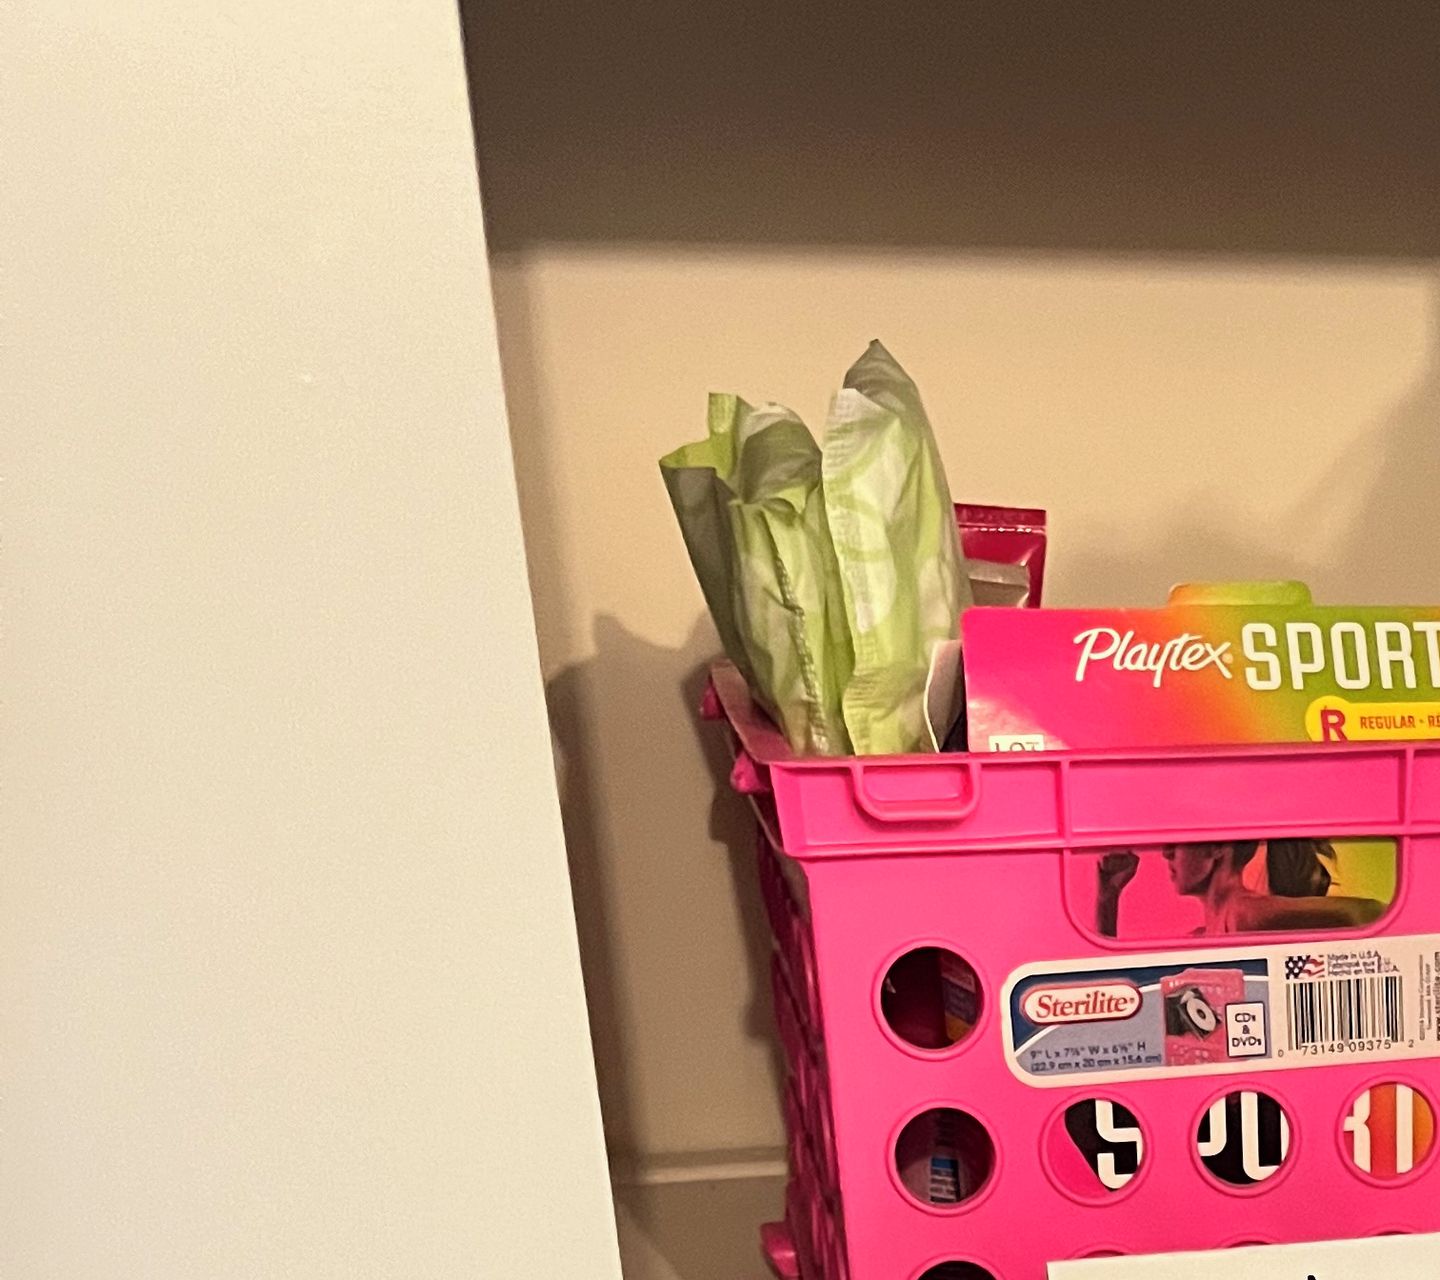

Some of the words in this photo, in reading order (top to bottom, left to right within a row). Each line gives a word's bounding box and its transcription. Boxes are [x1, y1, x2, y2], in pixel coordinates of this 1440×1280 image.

[1073, 626, 1233, 688] Playtex
[1320, 706, 1348, 742] R
[1359, 715, 1416, 730] REGULAR
[1035, 989, 1129, 1019] Sterilite
[1433, 951, 1440, 1042] www.sterilite.com
[1234, 1011, 1257, 1023] CDs
[1088, 1045, 1101, 1055] W
[1137, 1041, 1147, 1051] H
[1231, 1036, 1263, 1048] DVDs
[1278, 1048, 1285, 1058] 0
[1302, 1043, 1345, 1056] 73149
[1349, 1040, 1392, 1053] 09375
[1407, 1039, 1415, 1049] 2
